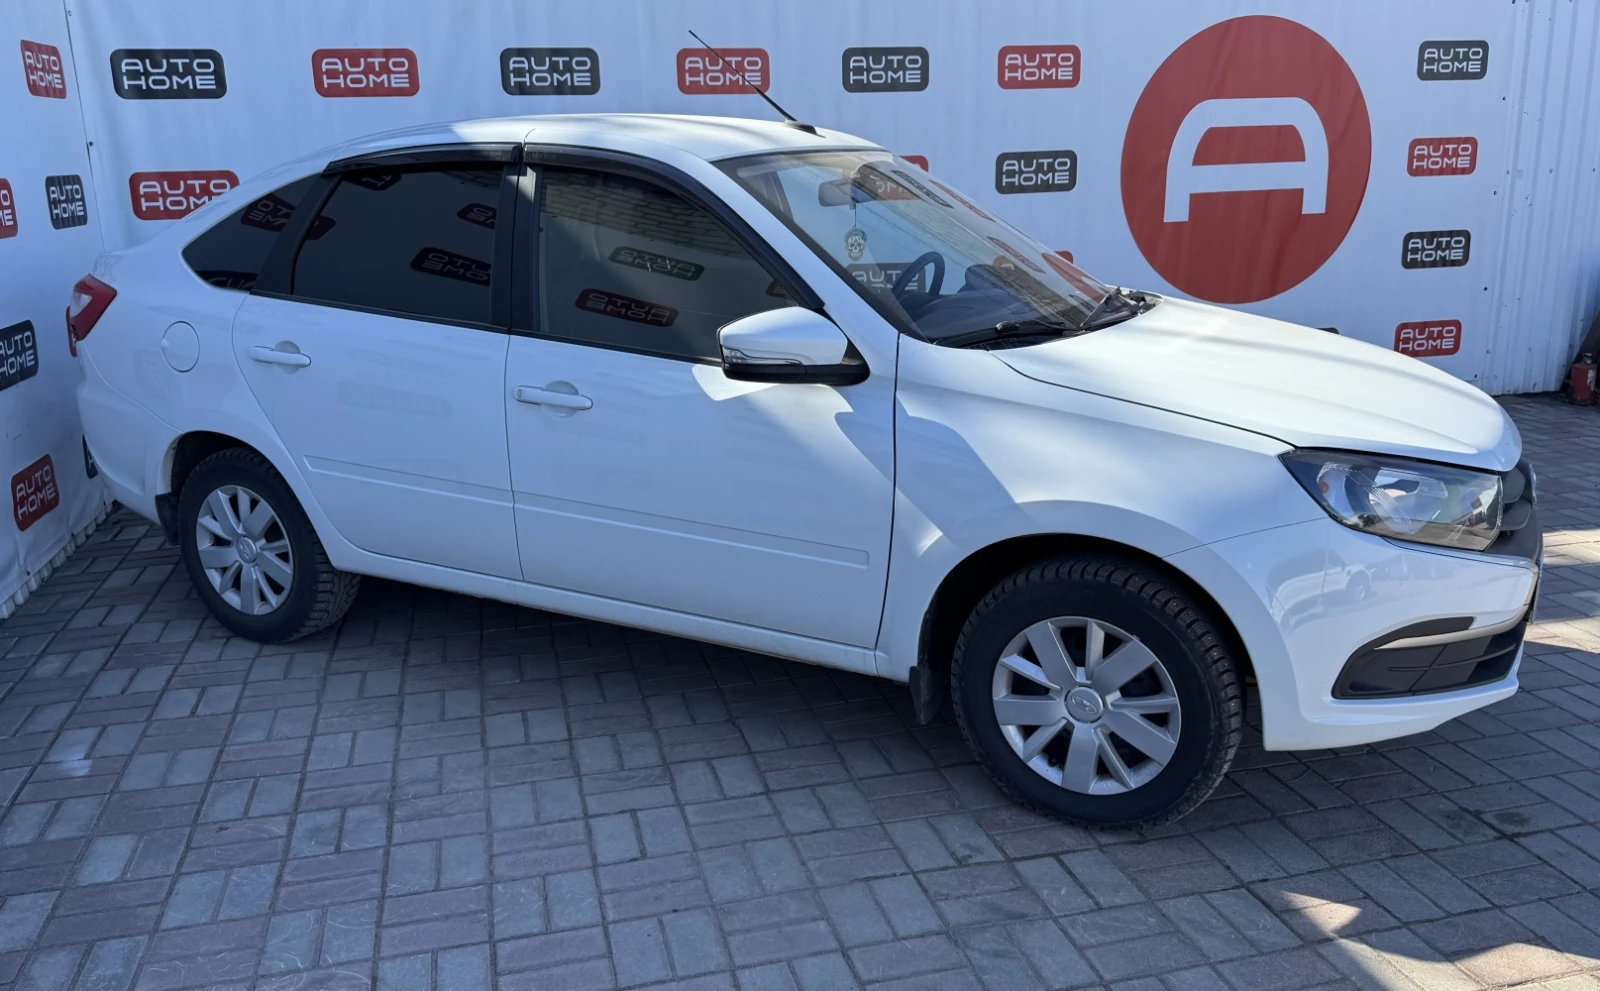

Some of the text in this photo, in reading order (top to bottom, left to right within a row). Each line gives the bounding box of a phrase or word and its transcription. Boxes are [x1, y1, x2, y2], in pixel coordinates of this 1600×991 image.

[25, 51, 60, 71] AUTO
[1005, 53, 1074, 67] AUTO
[1424, 48, 1483, 60] AUTO
[121, 58, 215, 73] AUTO
[322, 58, 409, 72] AUTO
[509, 57, 591, 70] AUTO
[685, 56, 762, 70] AUTO
[850, 55, 922, 69] AUTO
[1422, 61, 1481, 73] HOME
[28, 68, 63, 89] HOME
[323, 74, 410, 88] HOME
[510, 72, 592, 86] HOME
[685, 72, 762, 86] HOME
[850, 70, 921, 84] HOME
[1004, 67, 1073, 81] HOME
[123, 75, 216, 90] HOME
[1414, 144, 1472, 157] AUTO
[1003, 158, 1071, 172] AUTO
[1413, 156, 1470, 169] HOME
[1002, 171, 1070, 186] HOME
[49, 185, 82, 201] AUTO
[139, 179, 231, 195] AUTO
[52, 201, 84, 219] HOME
[141, 195, 220, 211] HOM
[1408, 236, 1465, 250] AUTO
[1407, 249, 1464, 262] HOME
[852, 269, 919, 282] AUT
[1400, 326, 1456, 340] AUTO
[1399, 338, 1454, 351] HOME
[16, 465, 52, 502] AUTO
[18, 482, 56, 520] HOME
